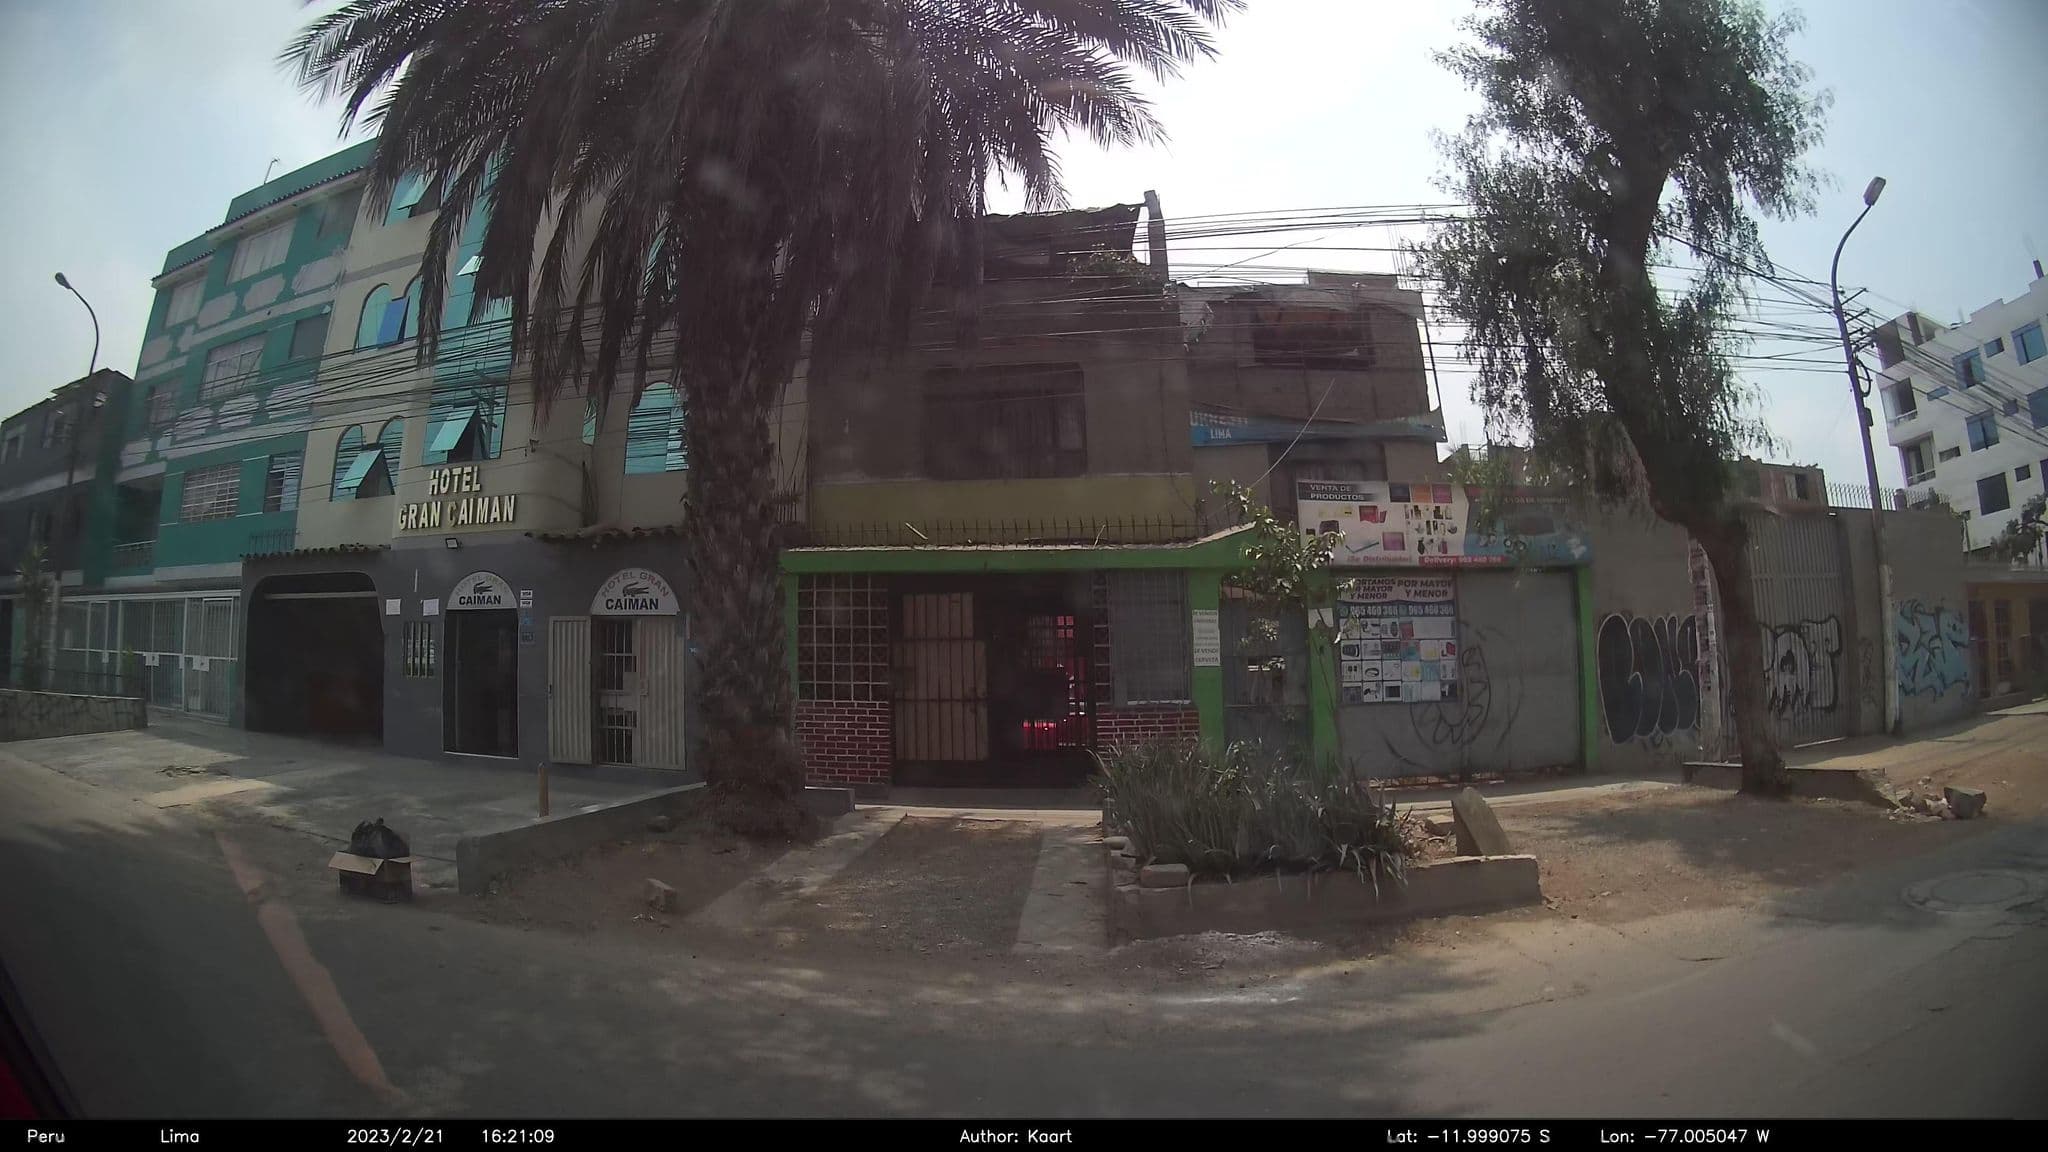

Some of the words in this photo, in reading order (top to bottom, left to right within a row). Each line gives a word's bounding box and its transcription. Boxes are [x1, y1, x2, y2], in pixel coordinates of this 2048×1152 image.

[428, 465, 481, 496] HOTEL
[1310, 484, 1338, 492] VENTA
[1310, 492, 1364, 501] PRODUCTOS
[399, 500, 441, 531] GRAN
[447, 494, 516, 528] CAIMAN
[602, 571, 637, 598] HOTEL
[640, 572, 669, 598] GRAN
[1397, 579, 1418, 588] POR
[1357, 592, 1388, 600] MENOR
[1413, 589, 1448, 598] MENOR
[458, 595, 502, 606] CAIMAN
[605, 598, 659, 611] CAIMAN
